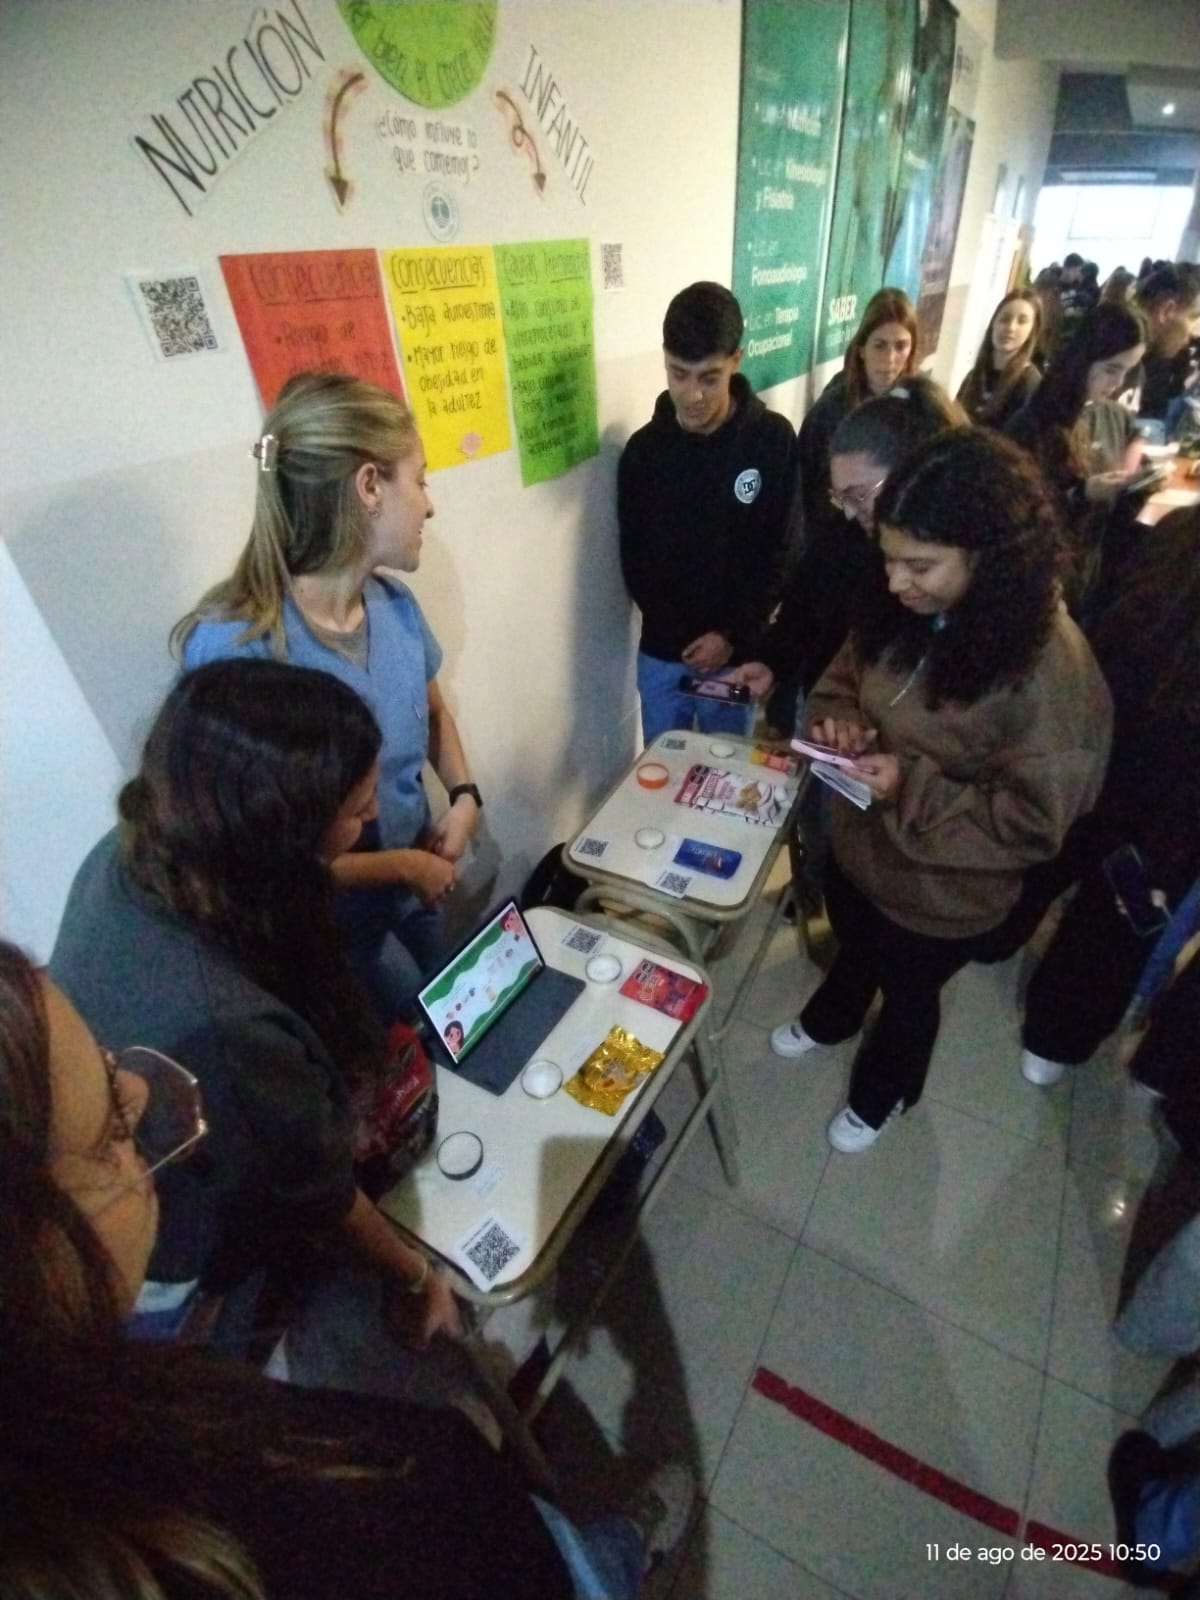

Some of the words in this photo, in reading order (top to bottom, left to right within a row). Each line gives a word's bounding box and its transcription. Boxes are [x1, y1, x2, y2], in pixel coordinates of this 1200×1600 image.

[134, 0, 326, 217] NUTRICIÓN
[519, 44, 597, 206] INFANTIL
[391, 254, 486, 290] Consecuencias
[828, 294, 857, 326] SABER
[483, 337, 497, 355] de
[470, 366, 484, 384] en
[443, 391, 482, 414] adultez
